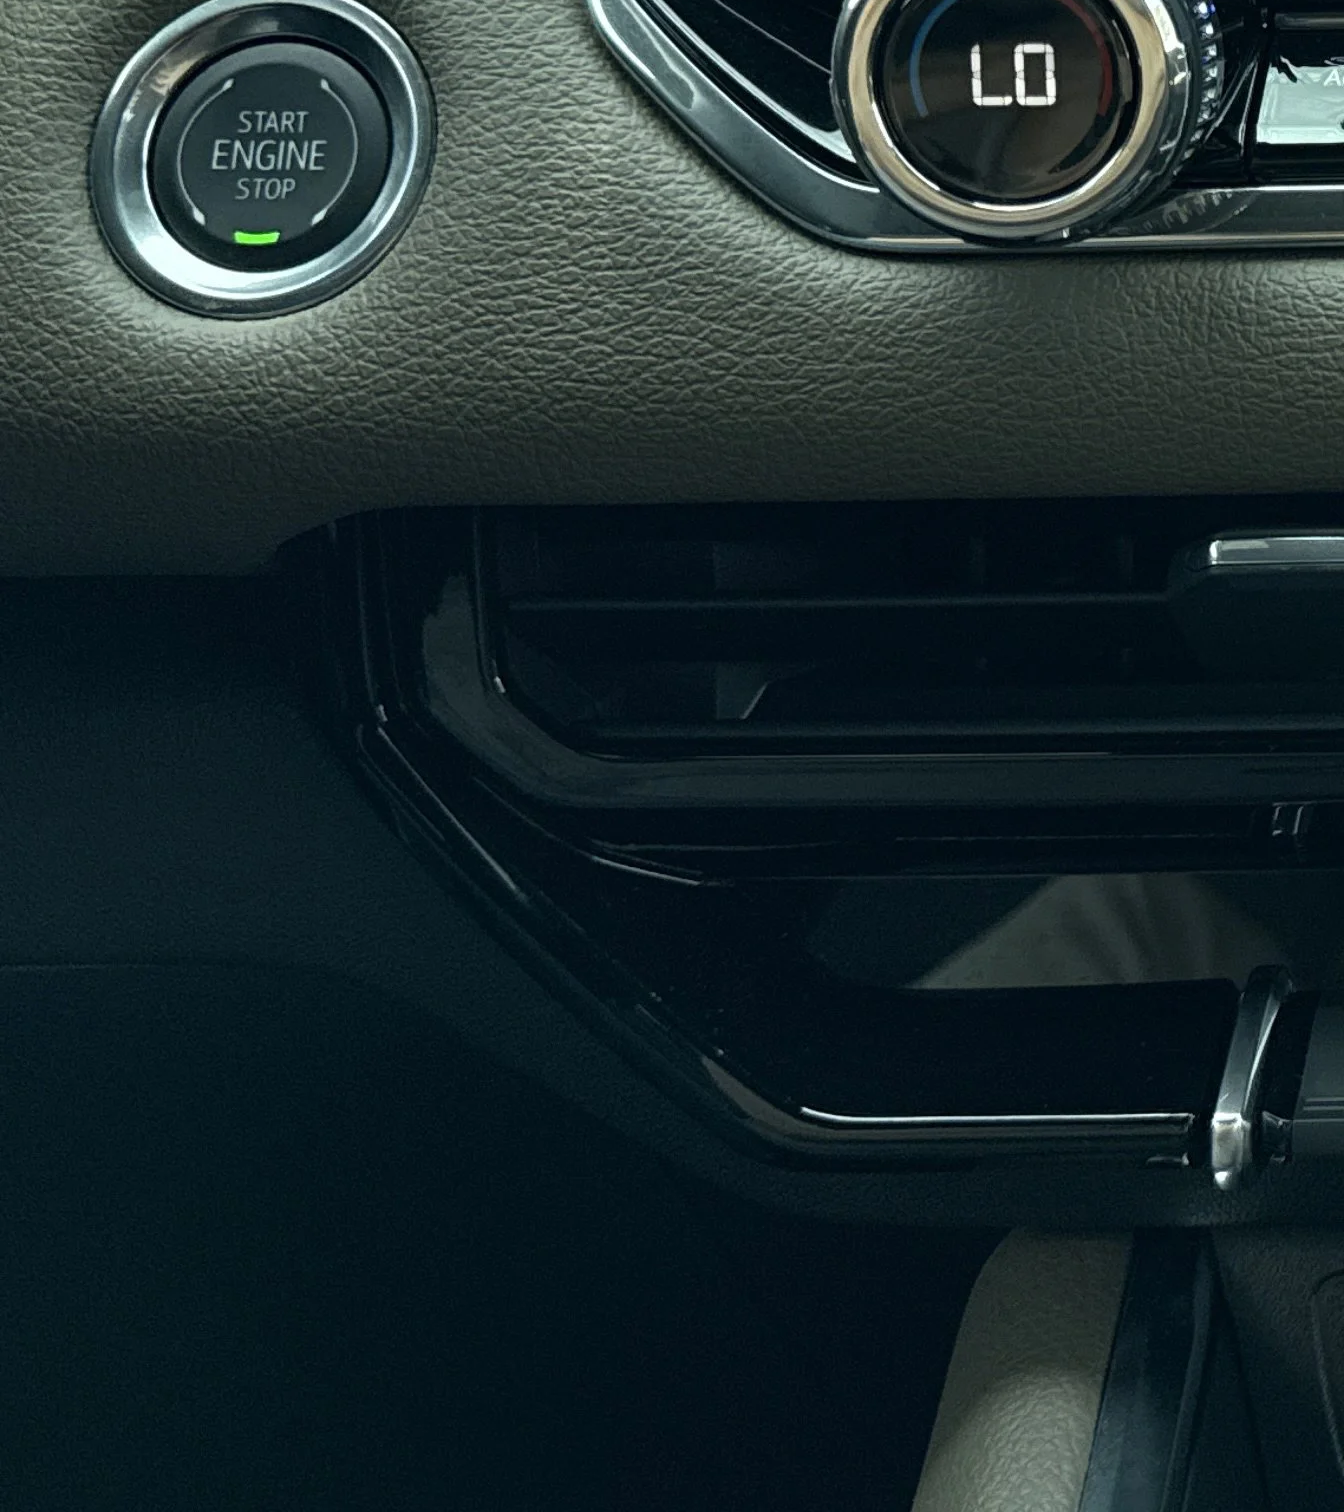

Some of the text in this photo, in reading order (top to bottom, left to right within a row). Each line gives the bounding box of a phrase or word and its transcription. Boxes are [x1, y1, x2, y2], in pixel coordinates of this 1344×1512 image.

[970, 42, 1057, 106] LO
[237, 111, 309, 134] START
[211, 140, 328, 171] ENGINE
[235, 178, 296, 200] STOP
